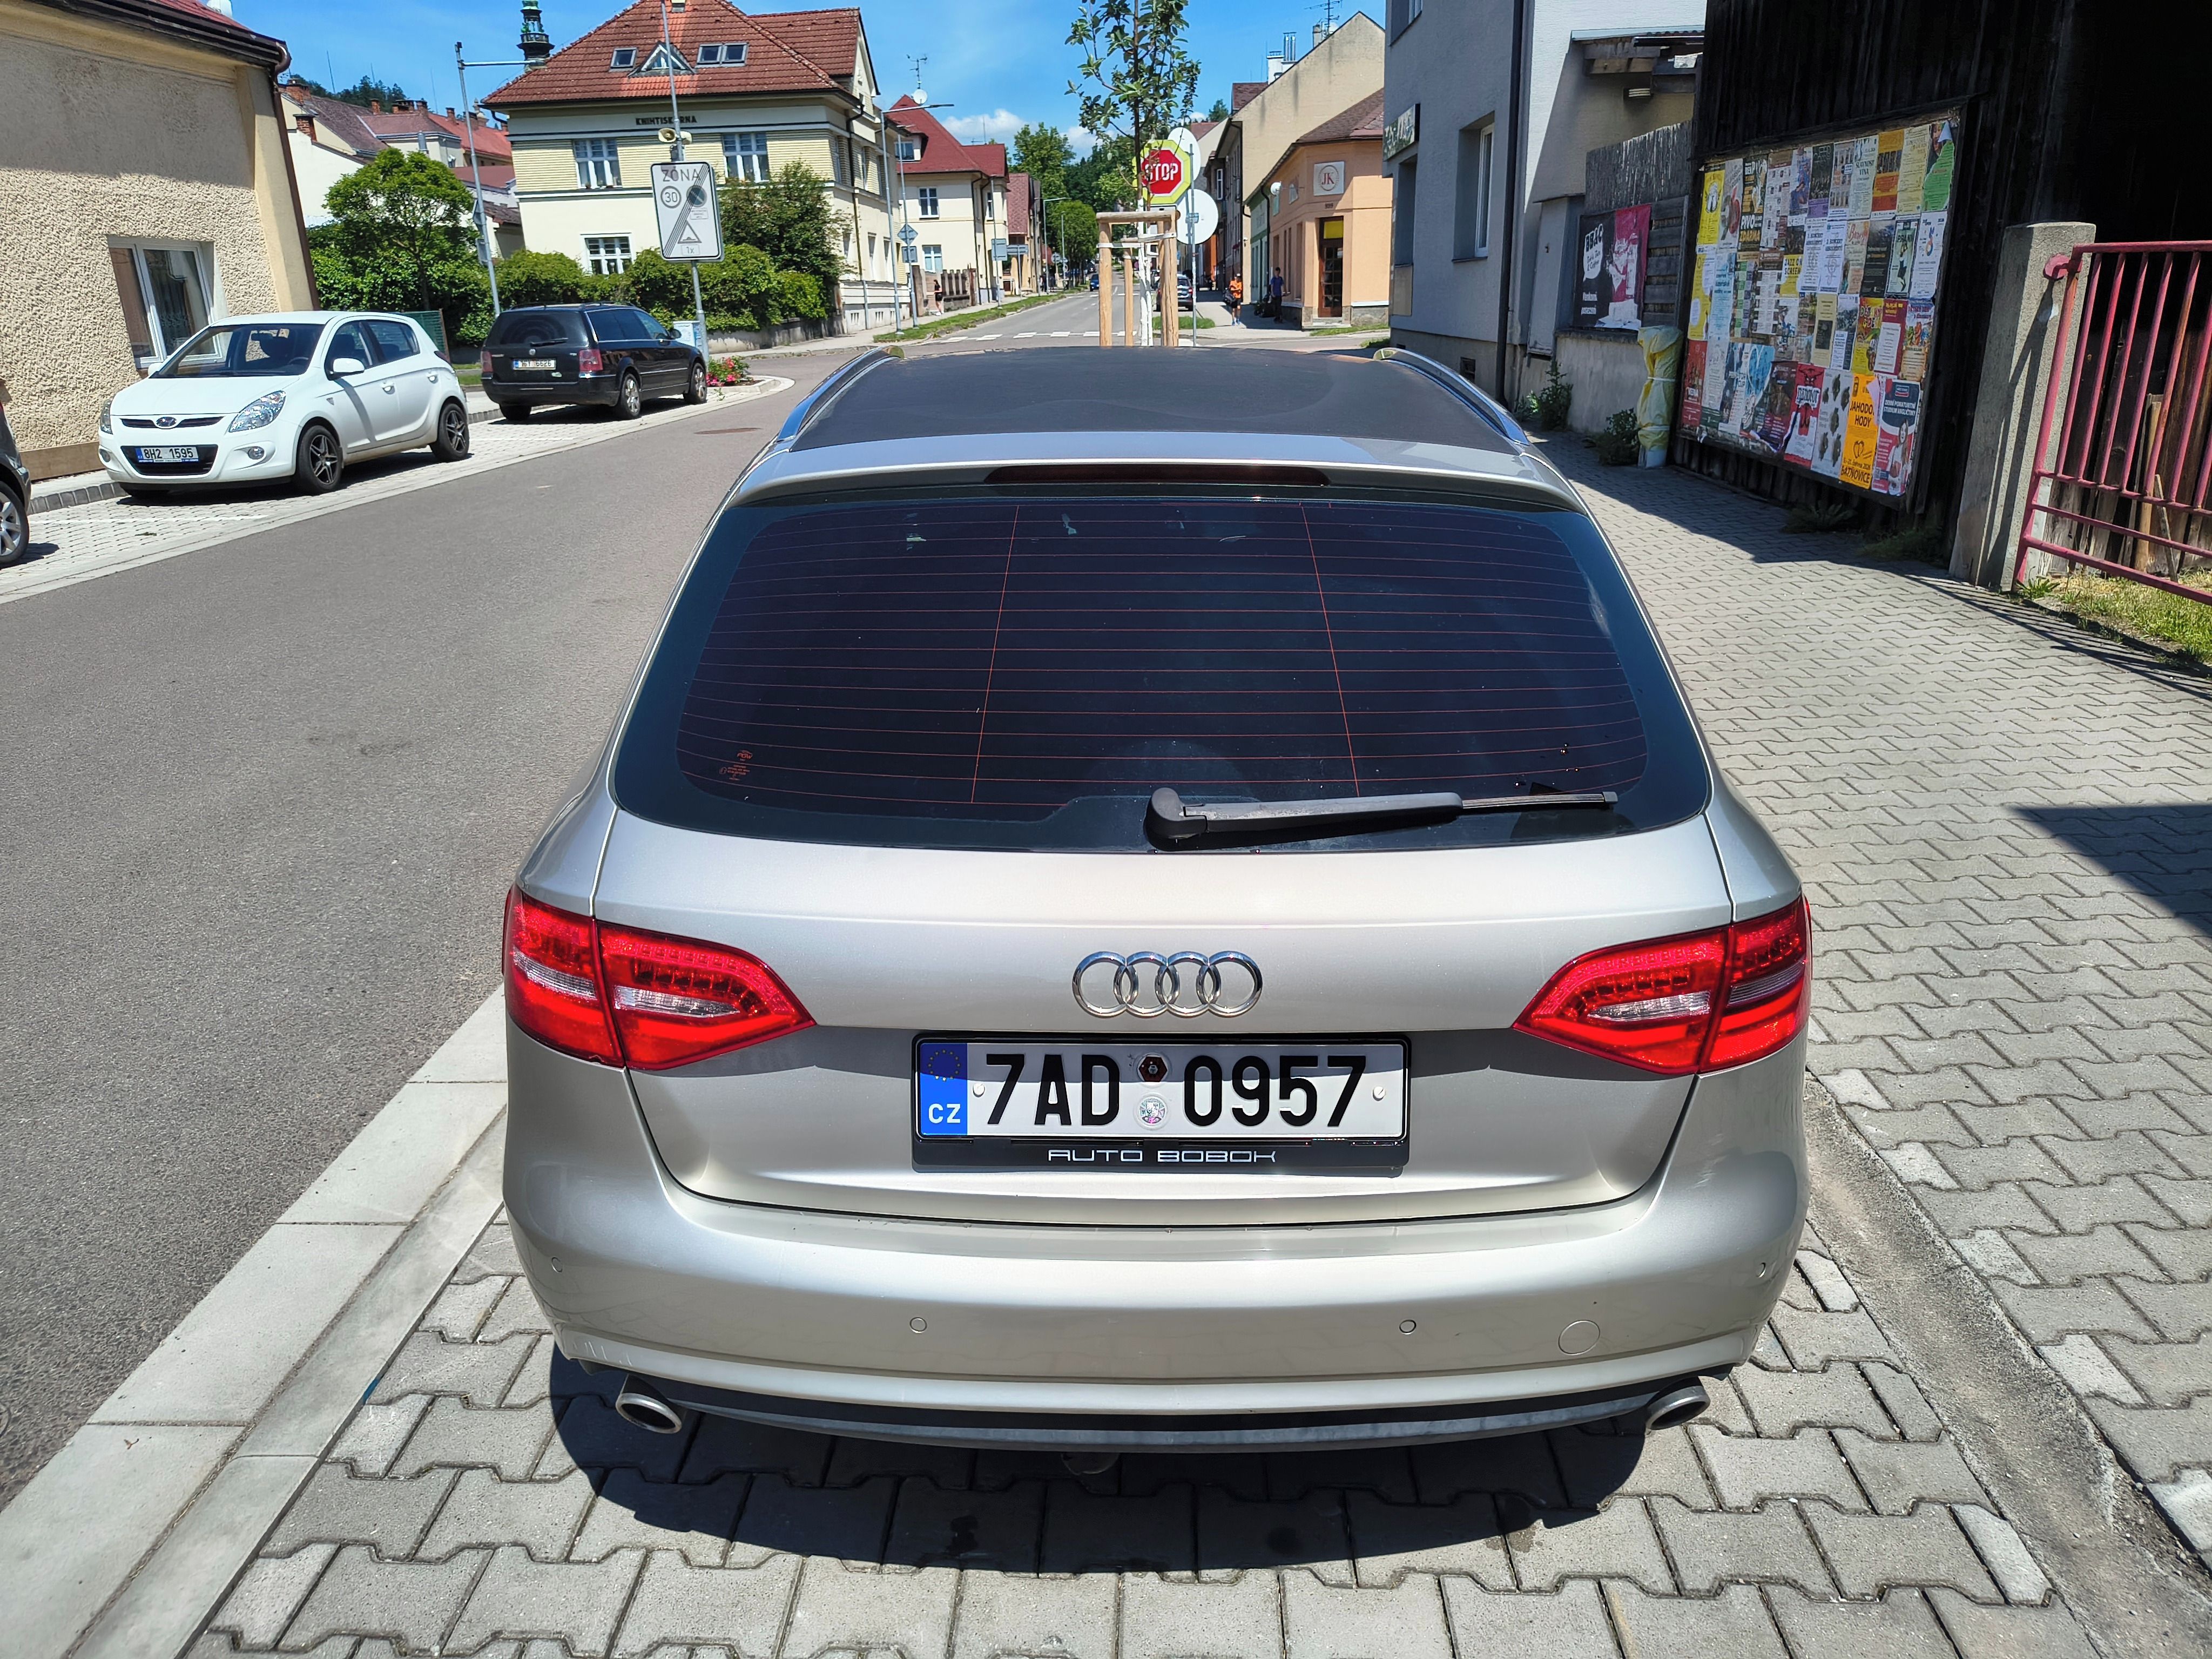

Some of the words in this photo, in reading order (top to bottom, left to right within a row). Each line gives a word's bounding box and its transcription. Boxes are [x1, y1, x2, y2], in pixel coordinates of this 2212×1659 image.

[636, 116, 697, 125] KNIHTISKRNA
[1145, 163, 1178, 180] STOP
[1322, 172, 1334, 185] JK
[665, 192, 678, 203] 30
[1741, 214, 1755, 229] PIVO
[1739, 230, 1761, 242] ZDARMA
[1850, 401, 1874, 415] JAHODO
[1855, 415, 1871, 428] HODY
[144, 449, 162, 459] 8H2
[170, 448, 193, 458] 1595
[986, 1054, 1120, 1126] 7AD
[1184, 1055, 1367, 1127] 0957
[928, 1103, 961, 1124] CZ
[1047, 1150, 1143, 1162] AUTO
[1157, 1150, 1277, 1163] BOBOK
